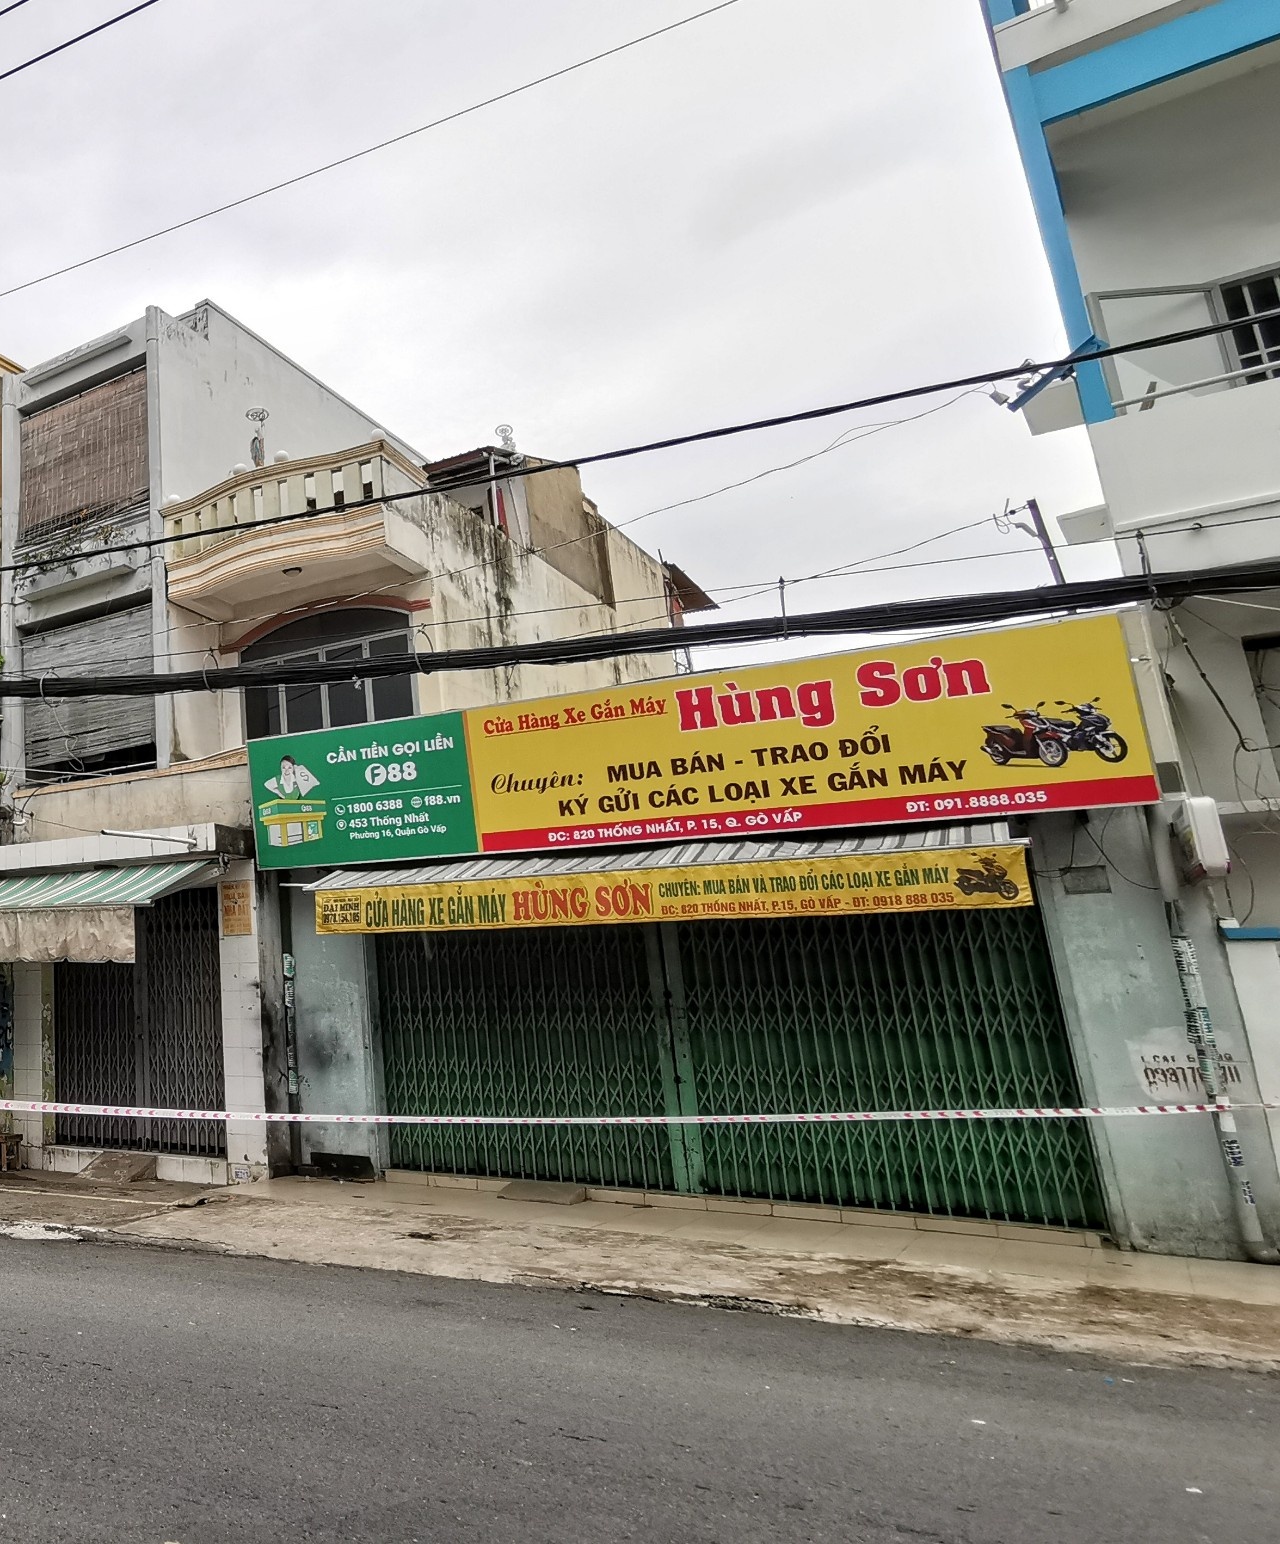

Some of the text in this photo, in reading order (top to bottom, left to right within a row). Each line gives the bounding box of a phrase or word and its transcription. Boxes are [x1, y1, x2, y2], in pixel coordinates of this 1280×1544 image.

[675, 656, 992, 732] Hùng Sơn
[484, 697, 666, 735] Cửa Hàng Xe Gắn Máy
[326, 732, 454, 764] CẦN TIỀN GỌI LIỀN
[607, 761, 662, 783] MUA
[670, 751, 725, 775] BÁN
[751, 742, 829, 767] TRAO
[839, 725, 892, 755] ĐỔI
[491, 771, 584, 794] Chuyên:
[558, 757, 968, 816] KÝ GỬI CÁC LOẠI XE GẮN MÁY
[347, 794, 461, 814] 1800 6388 f88.vn
[906, 790, 1048, 814] ĐT: 091.8888.035
[349, 812, 430, 828] 453 Thống Nhất
[349, 823, 447, 840] Phường 16, Quận Gò Vấp
[548, 808, 802, 842] ĐC: 820 THỐNG NHẤT, P. 15, Q. GÒ VẤP
[658, 863, 949, 898] CHUYÊN: MUA BÁN VÀ TRAO ĐỔI CÁC LOẠI XE GẮN MÁY
[365, 878, 654, 928] CỬA HÀNG XE GẮN MÁY HÙNG SƠN
[661, 904, 678, 915] ĐC:
[681, 903, 699, 914] 820
[701, 898, 737, 913] THỐNG
[738, 897, 771, 912] NHẤT,
[771, 899, 798, 912] P.15,
[800, 896, 816, 910] GÒ
[819, 895, 841, 909] VẤP
[852, 896, 870, 908] ĐT:
[872, 895, 902, 907] 0918
[905, 894, 927, 905] 888
[931, 892, 954, 904] 035
